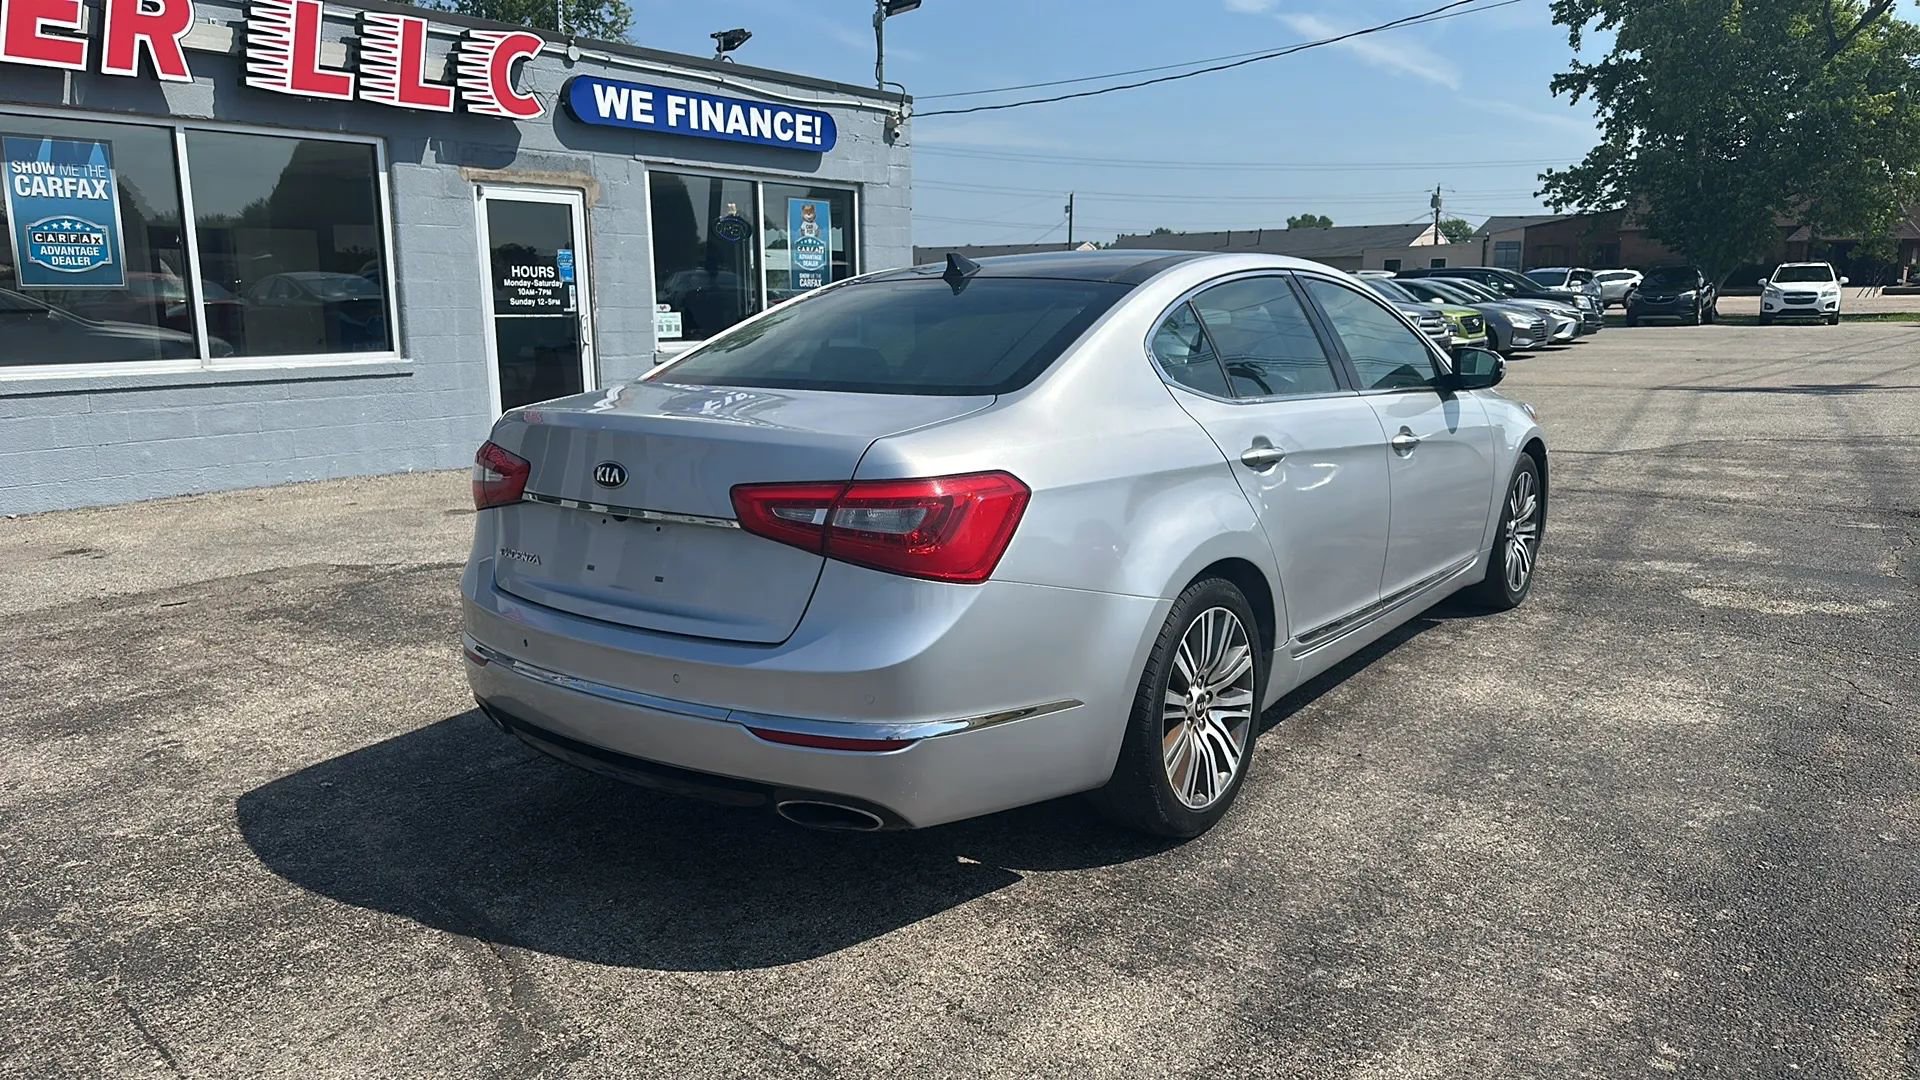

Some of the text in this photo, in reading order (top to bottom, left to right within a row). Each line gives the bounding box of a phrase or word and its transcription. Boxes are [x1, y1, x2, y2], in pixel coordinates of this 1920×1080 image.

[246, 0, 547, 119] LLC
[593, 83, 822, 145] WE FINANCE!
[11, 160, 107, 178] SHOW ME THE
[14, 175, 109, 200] CARFAX
[33, 232, 104, 245] CARFAX
[40, 245, 100, 256] ADVANTAGE
[51, 256, 91, 266] DEALER
[511, 265, 555, 278] HOURS
[509, 297, 536, 307] Sunday
[596, 466, 620, 484] KIA
